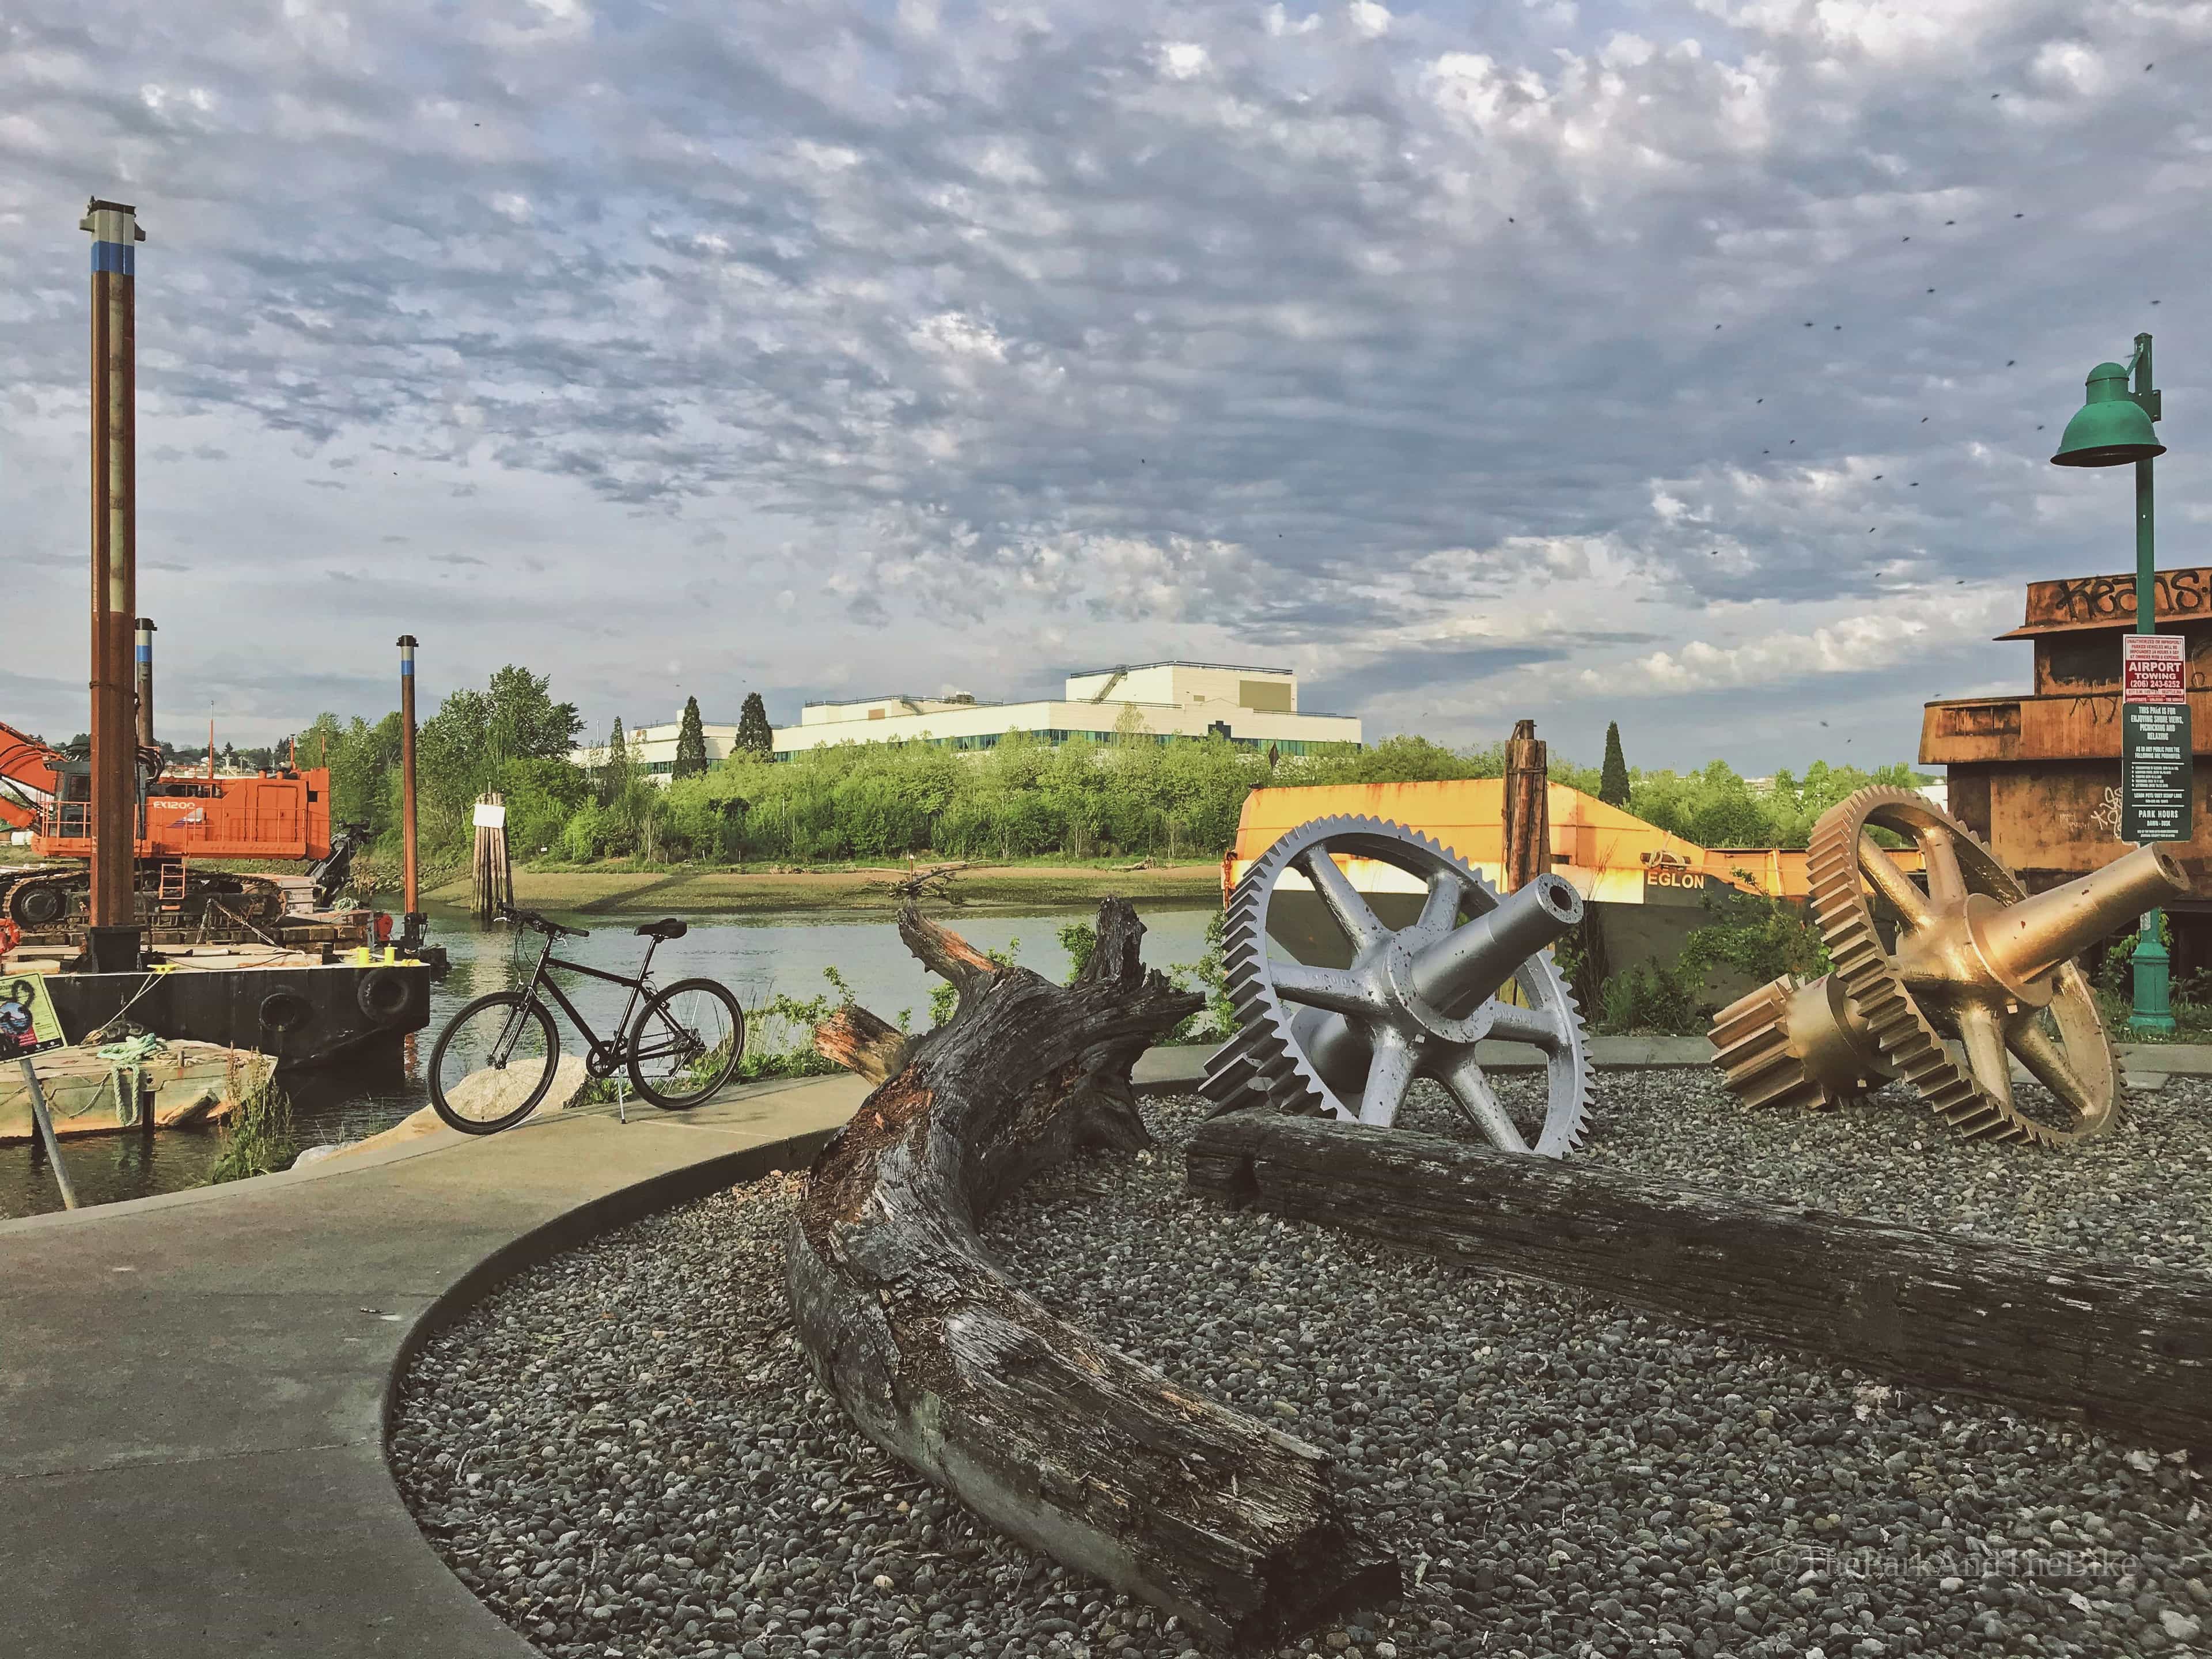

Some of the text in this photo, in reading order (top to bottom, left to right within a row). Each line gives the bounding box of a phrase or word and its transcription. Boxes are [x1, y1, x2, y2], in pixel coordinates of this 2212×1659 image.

[2128, 662, 2181, 672] AIRPORT
[153, 801, 196, 809] EX1200
[2138, 810, 2179, 818] PARK HOURS
[1647, 872, 1705, 889] EGLON
